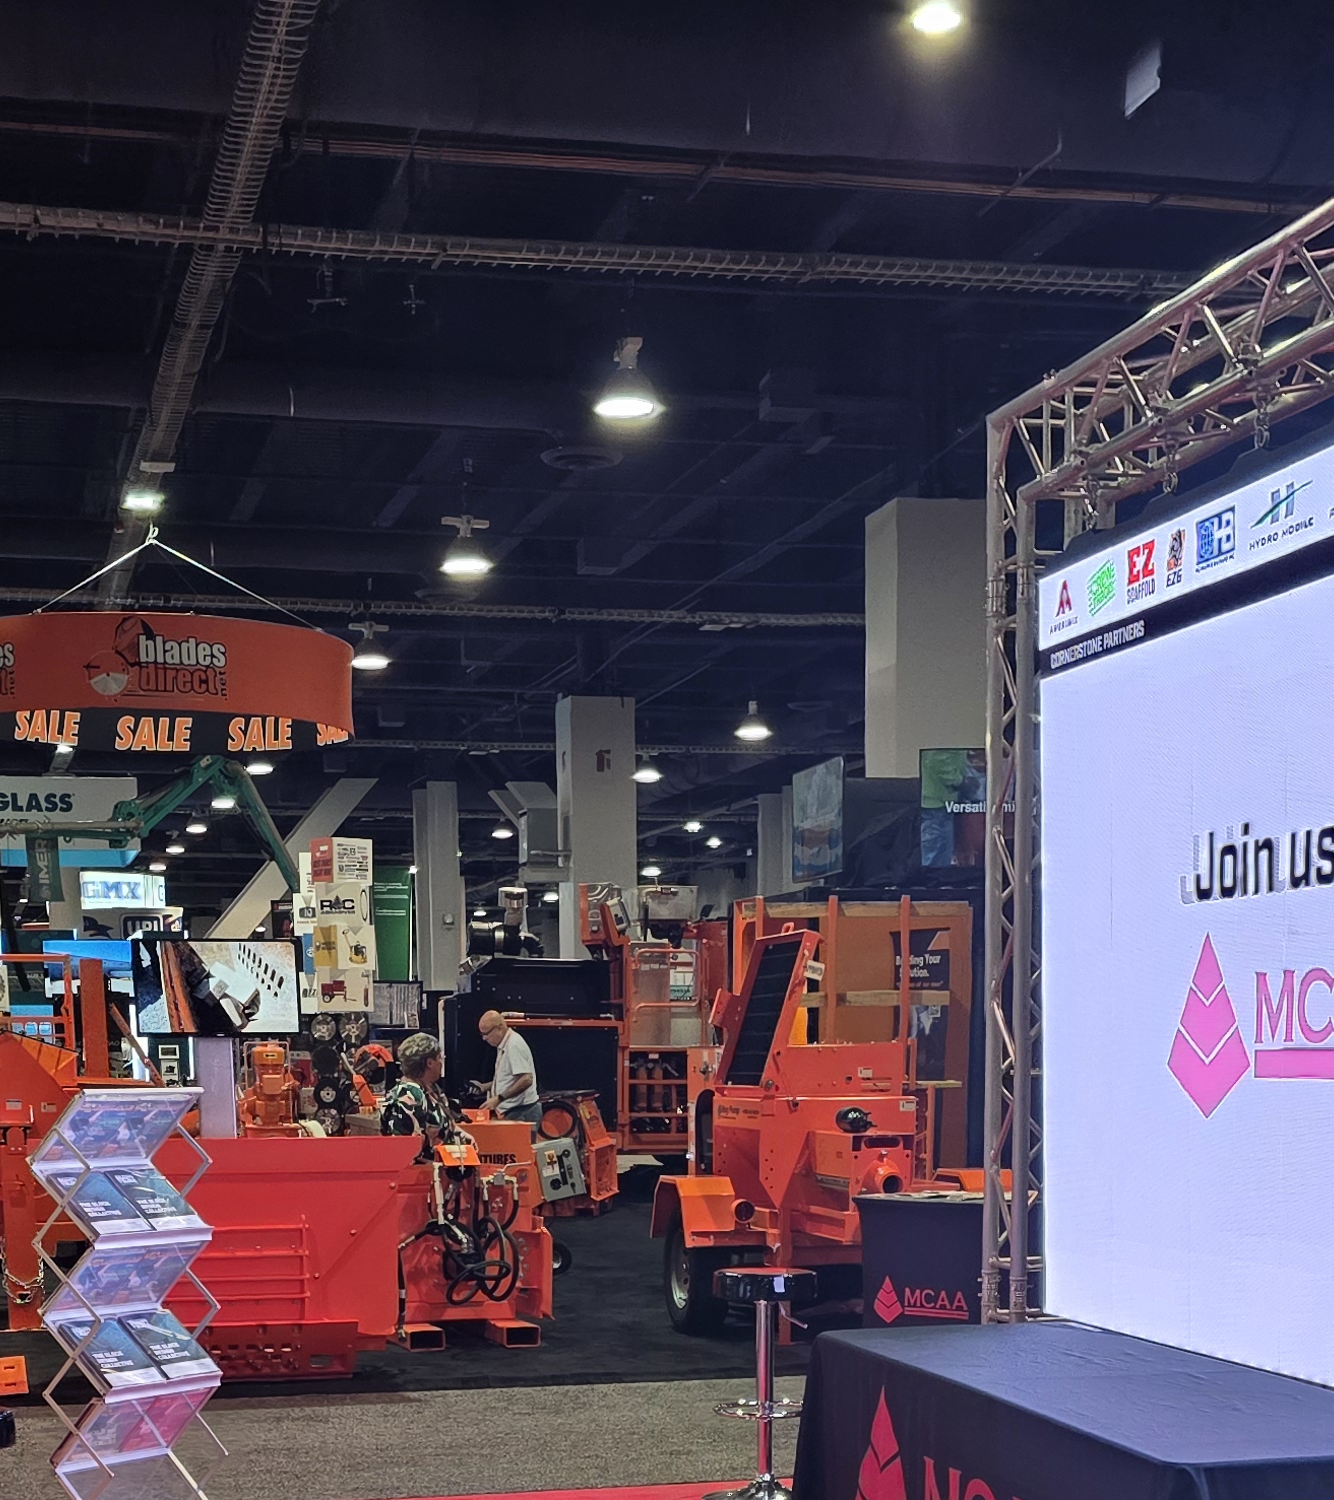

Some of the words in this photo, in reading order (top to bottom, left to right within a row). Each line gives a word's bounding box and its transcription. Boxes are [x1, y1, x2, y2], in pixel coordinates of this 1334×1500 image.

[1248, 533, 1279, 551] HYDRO
[1127, 538, 1155, 587] EZ
[1166, 569, 1182, 589] EZG
[138, 635, 227, 667] blades
[1050, 634, 1103, 670] CORNERSTONE
[1103, 619, 1145, 650] PARTNERS
[139, 664, 219, 695] direct
[14, 709, 80, 745] SALE
[115, 715, 192, 751] SALE
[227, 717, 293, 751] SALE
[1193, 822, 1273, 902] Join
[82, 881, 141, 900] GMX
[924, 954, 941, 965] Your
[905, 1287, 967, 1311] MCAA
